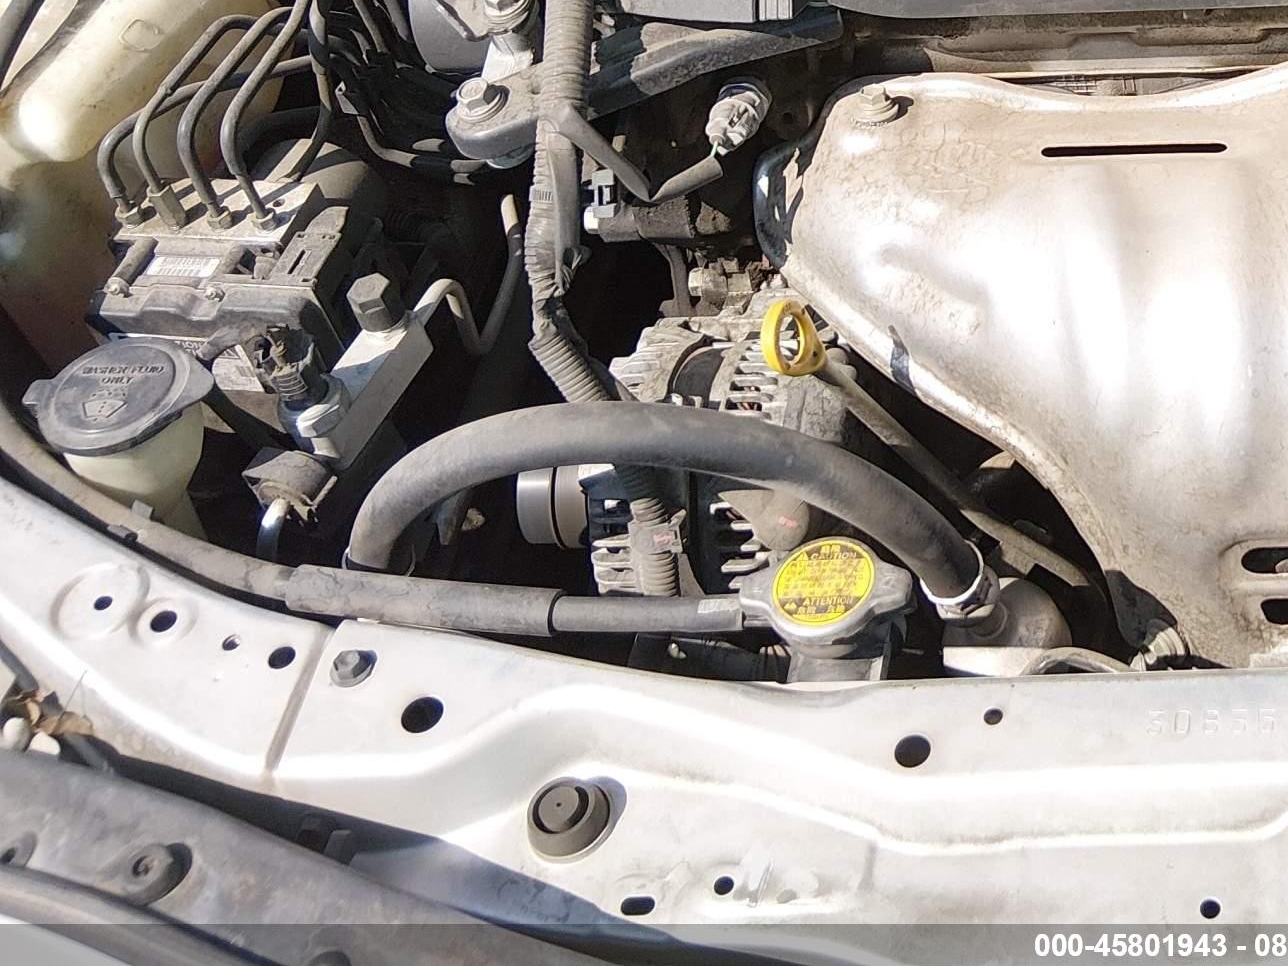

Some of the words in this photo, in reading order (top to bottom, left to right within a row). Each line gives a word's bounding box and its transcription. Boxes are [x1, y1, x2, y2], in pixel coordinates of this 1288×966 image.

[130, 365, 165, 375] FLUID
[101, 376, 134, 385] ONLY
[810, 552, 857, 562] CAUTION
[802, 594, 854, 607] ATTENTION
